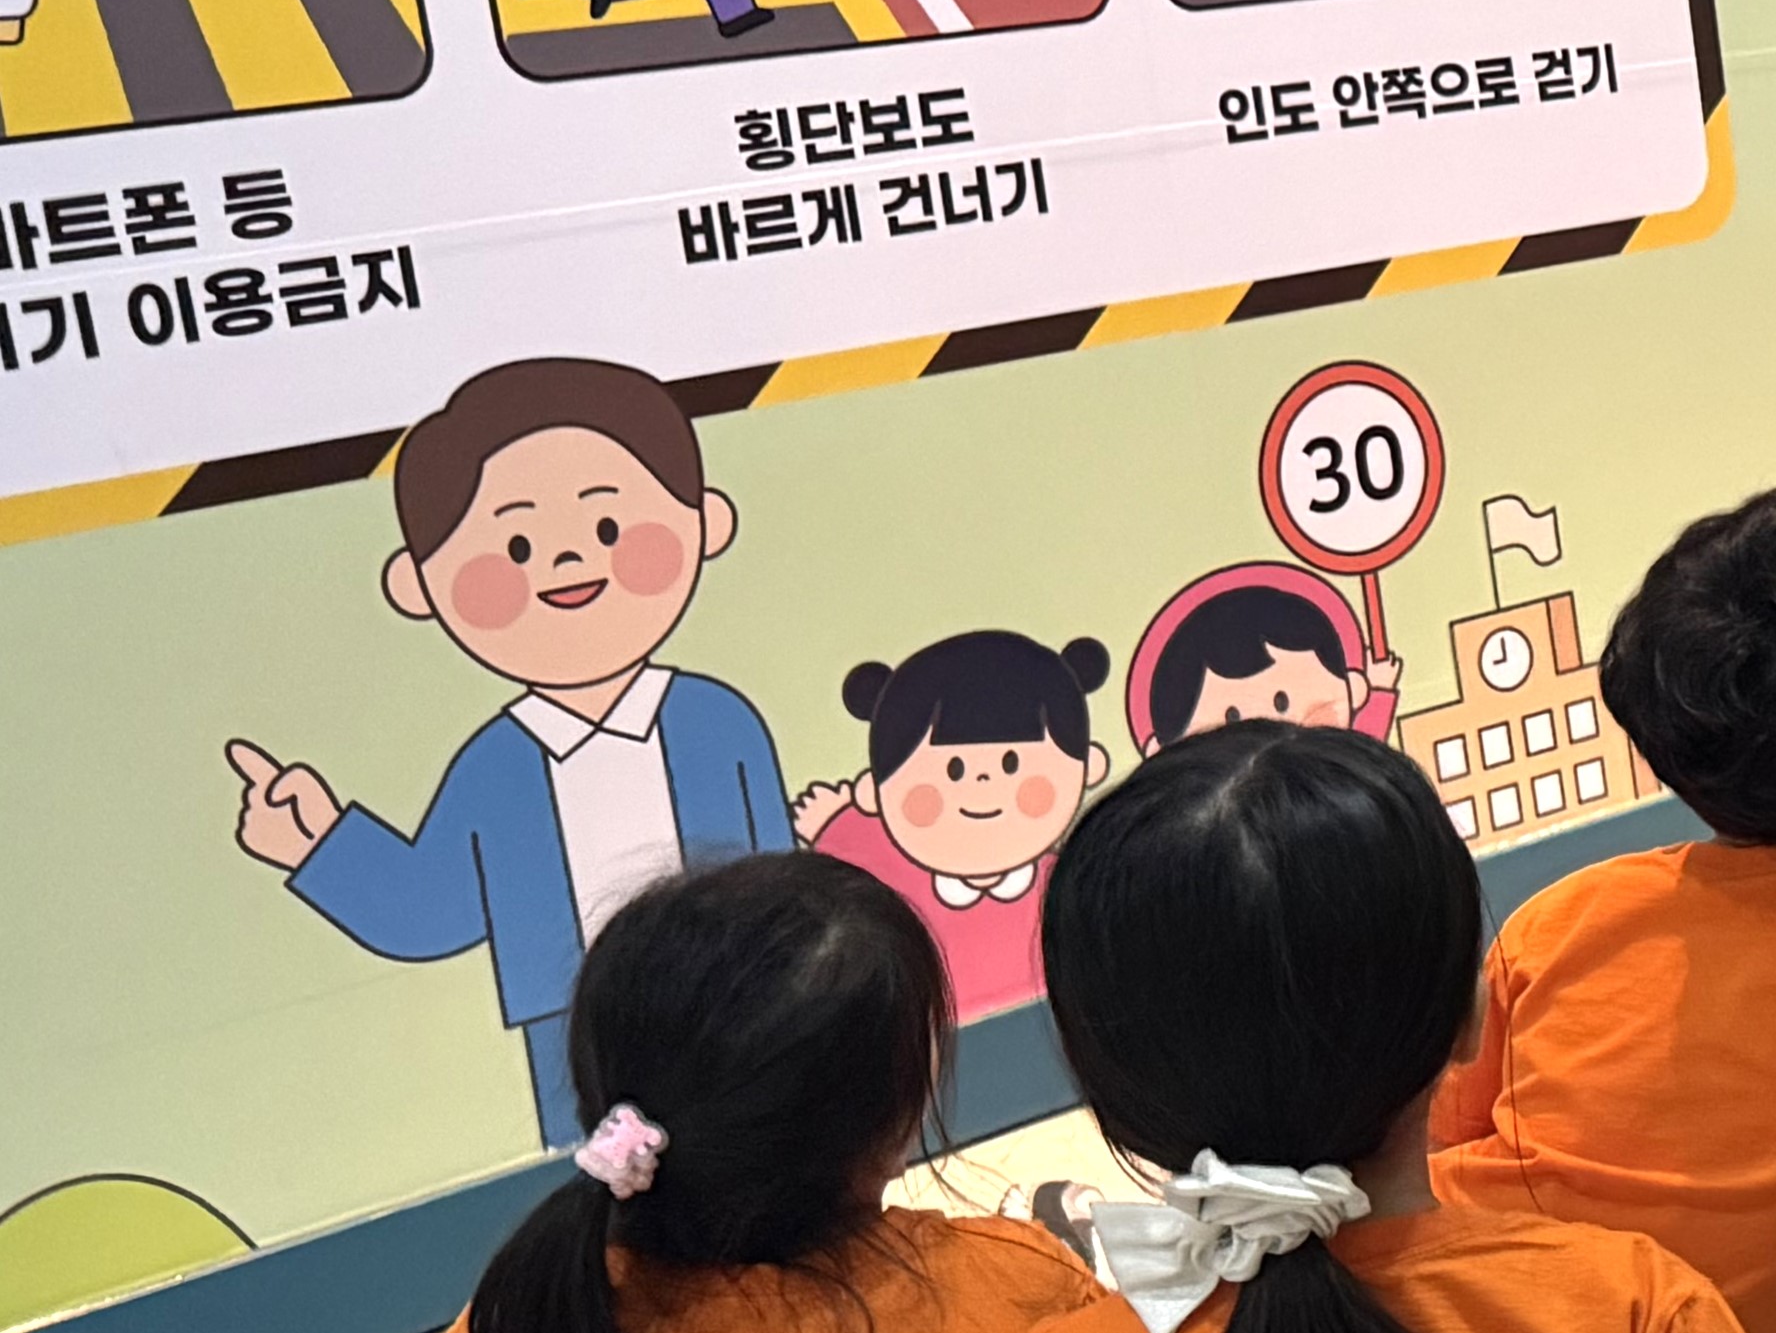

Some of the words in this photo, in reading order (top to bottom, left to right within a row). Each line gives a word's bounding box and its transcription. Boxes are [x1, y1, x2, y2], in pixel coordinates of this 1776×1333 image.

[733, 88, 975, 171] 횡단보도
[1218, 80, 1320, 145] 인도
[1332, 56, 1521, 129] 안쪽으로
[1531, 43, 1619, 103] 걷기
[222, 168, 294, 240] 등
[678, 183, 862, 265] 바르게
[879, 157, 1050, 237] 건너기
[0, 290, 101, 371] 기
[127, 245, 421, 347] 이용금지
[1301, 424, 1405, 513] 30
